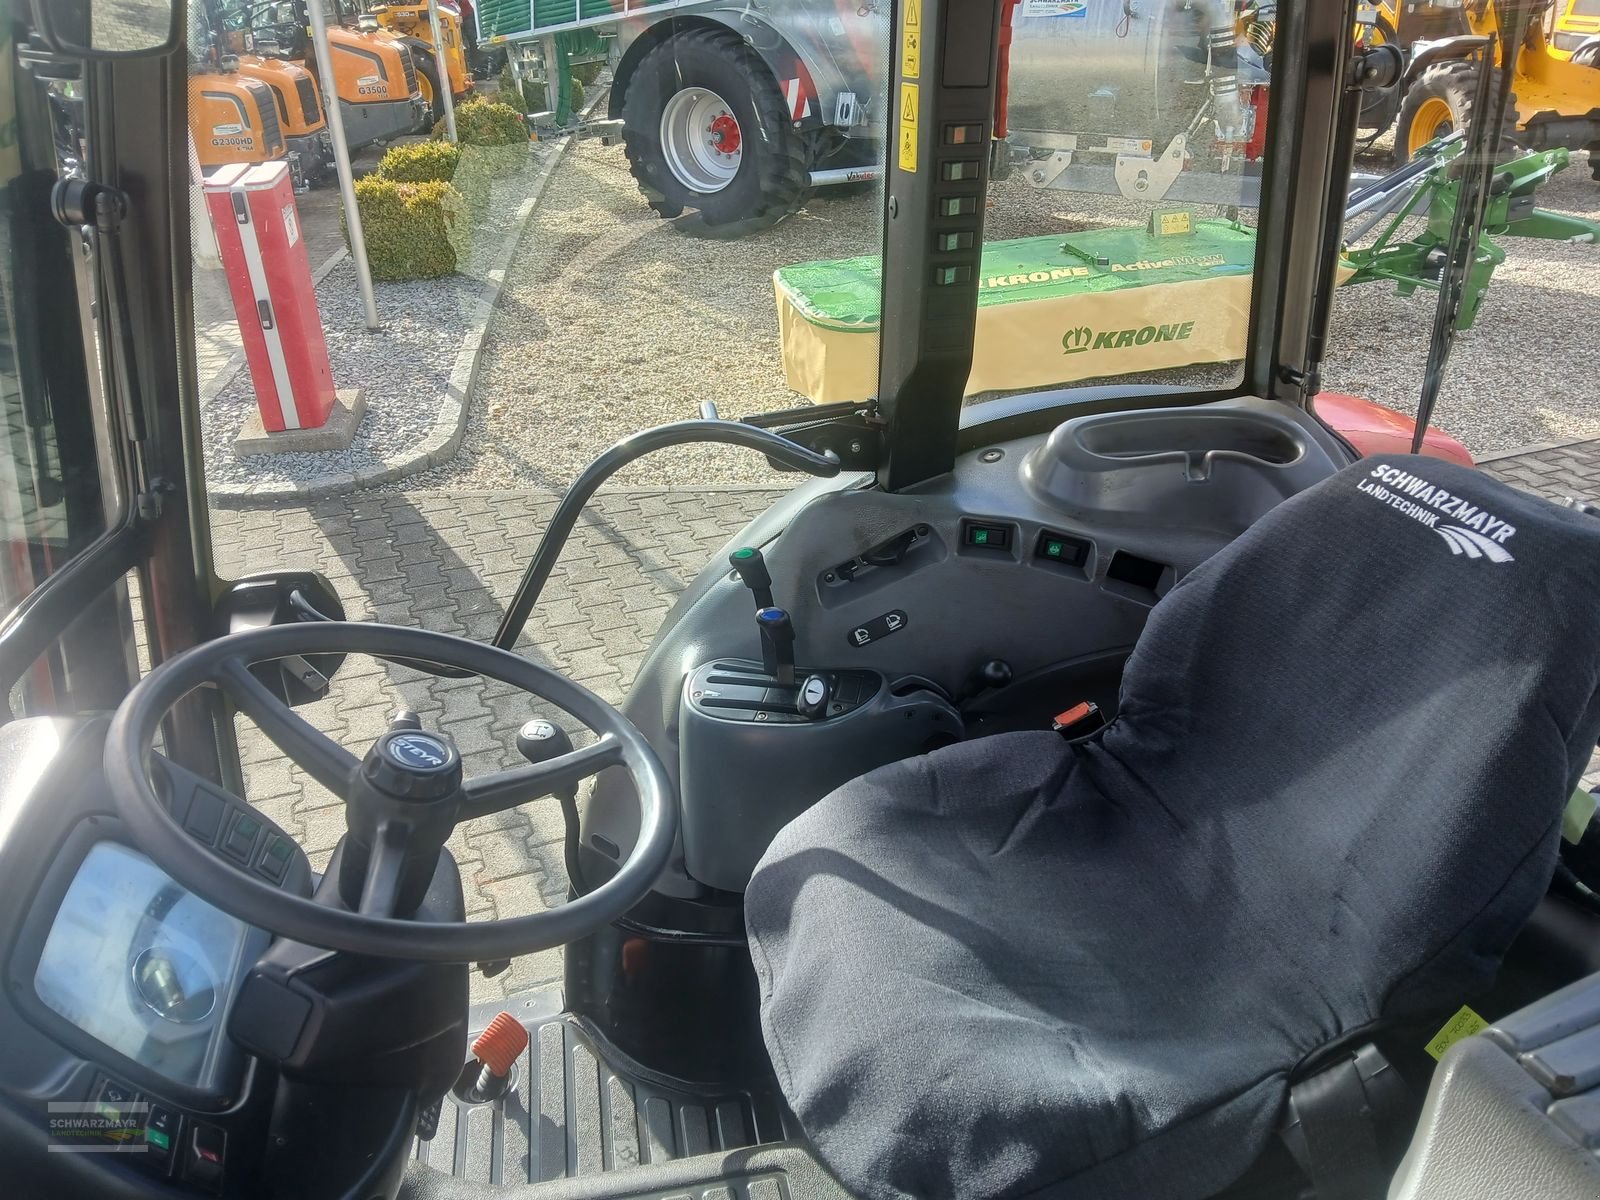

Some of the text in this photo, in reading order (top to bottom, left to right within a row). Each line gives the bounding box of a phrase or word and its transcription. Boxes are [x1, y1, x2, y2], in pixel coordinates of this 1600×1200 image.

[358, 85, 387, 95] G3500
[212, 137, 253, 146] G2300HD
[988, 266, 1089, 288] KRONE
[1092, 321, 1195, 350] KRONE
[1356, 478, 1440, 529] LANDTECHNIK
[1370, 464, 1517, 544] SCHWARZMAYR
[393, 739, 442, 765] STEYR
